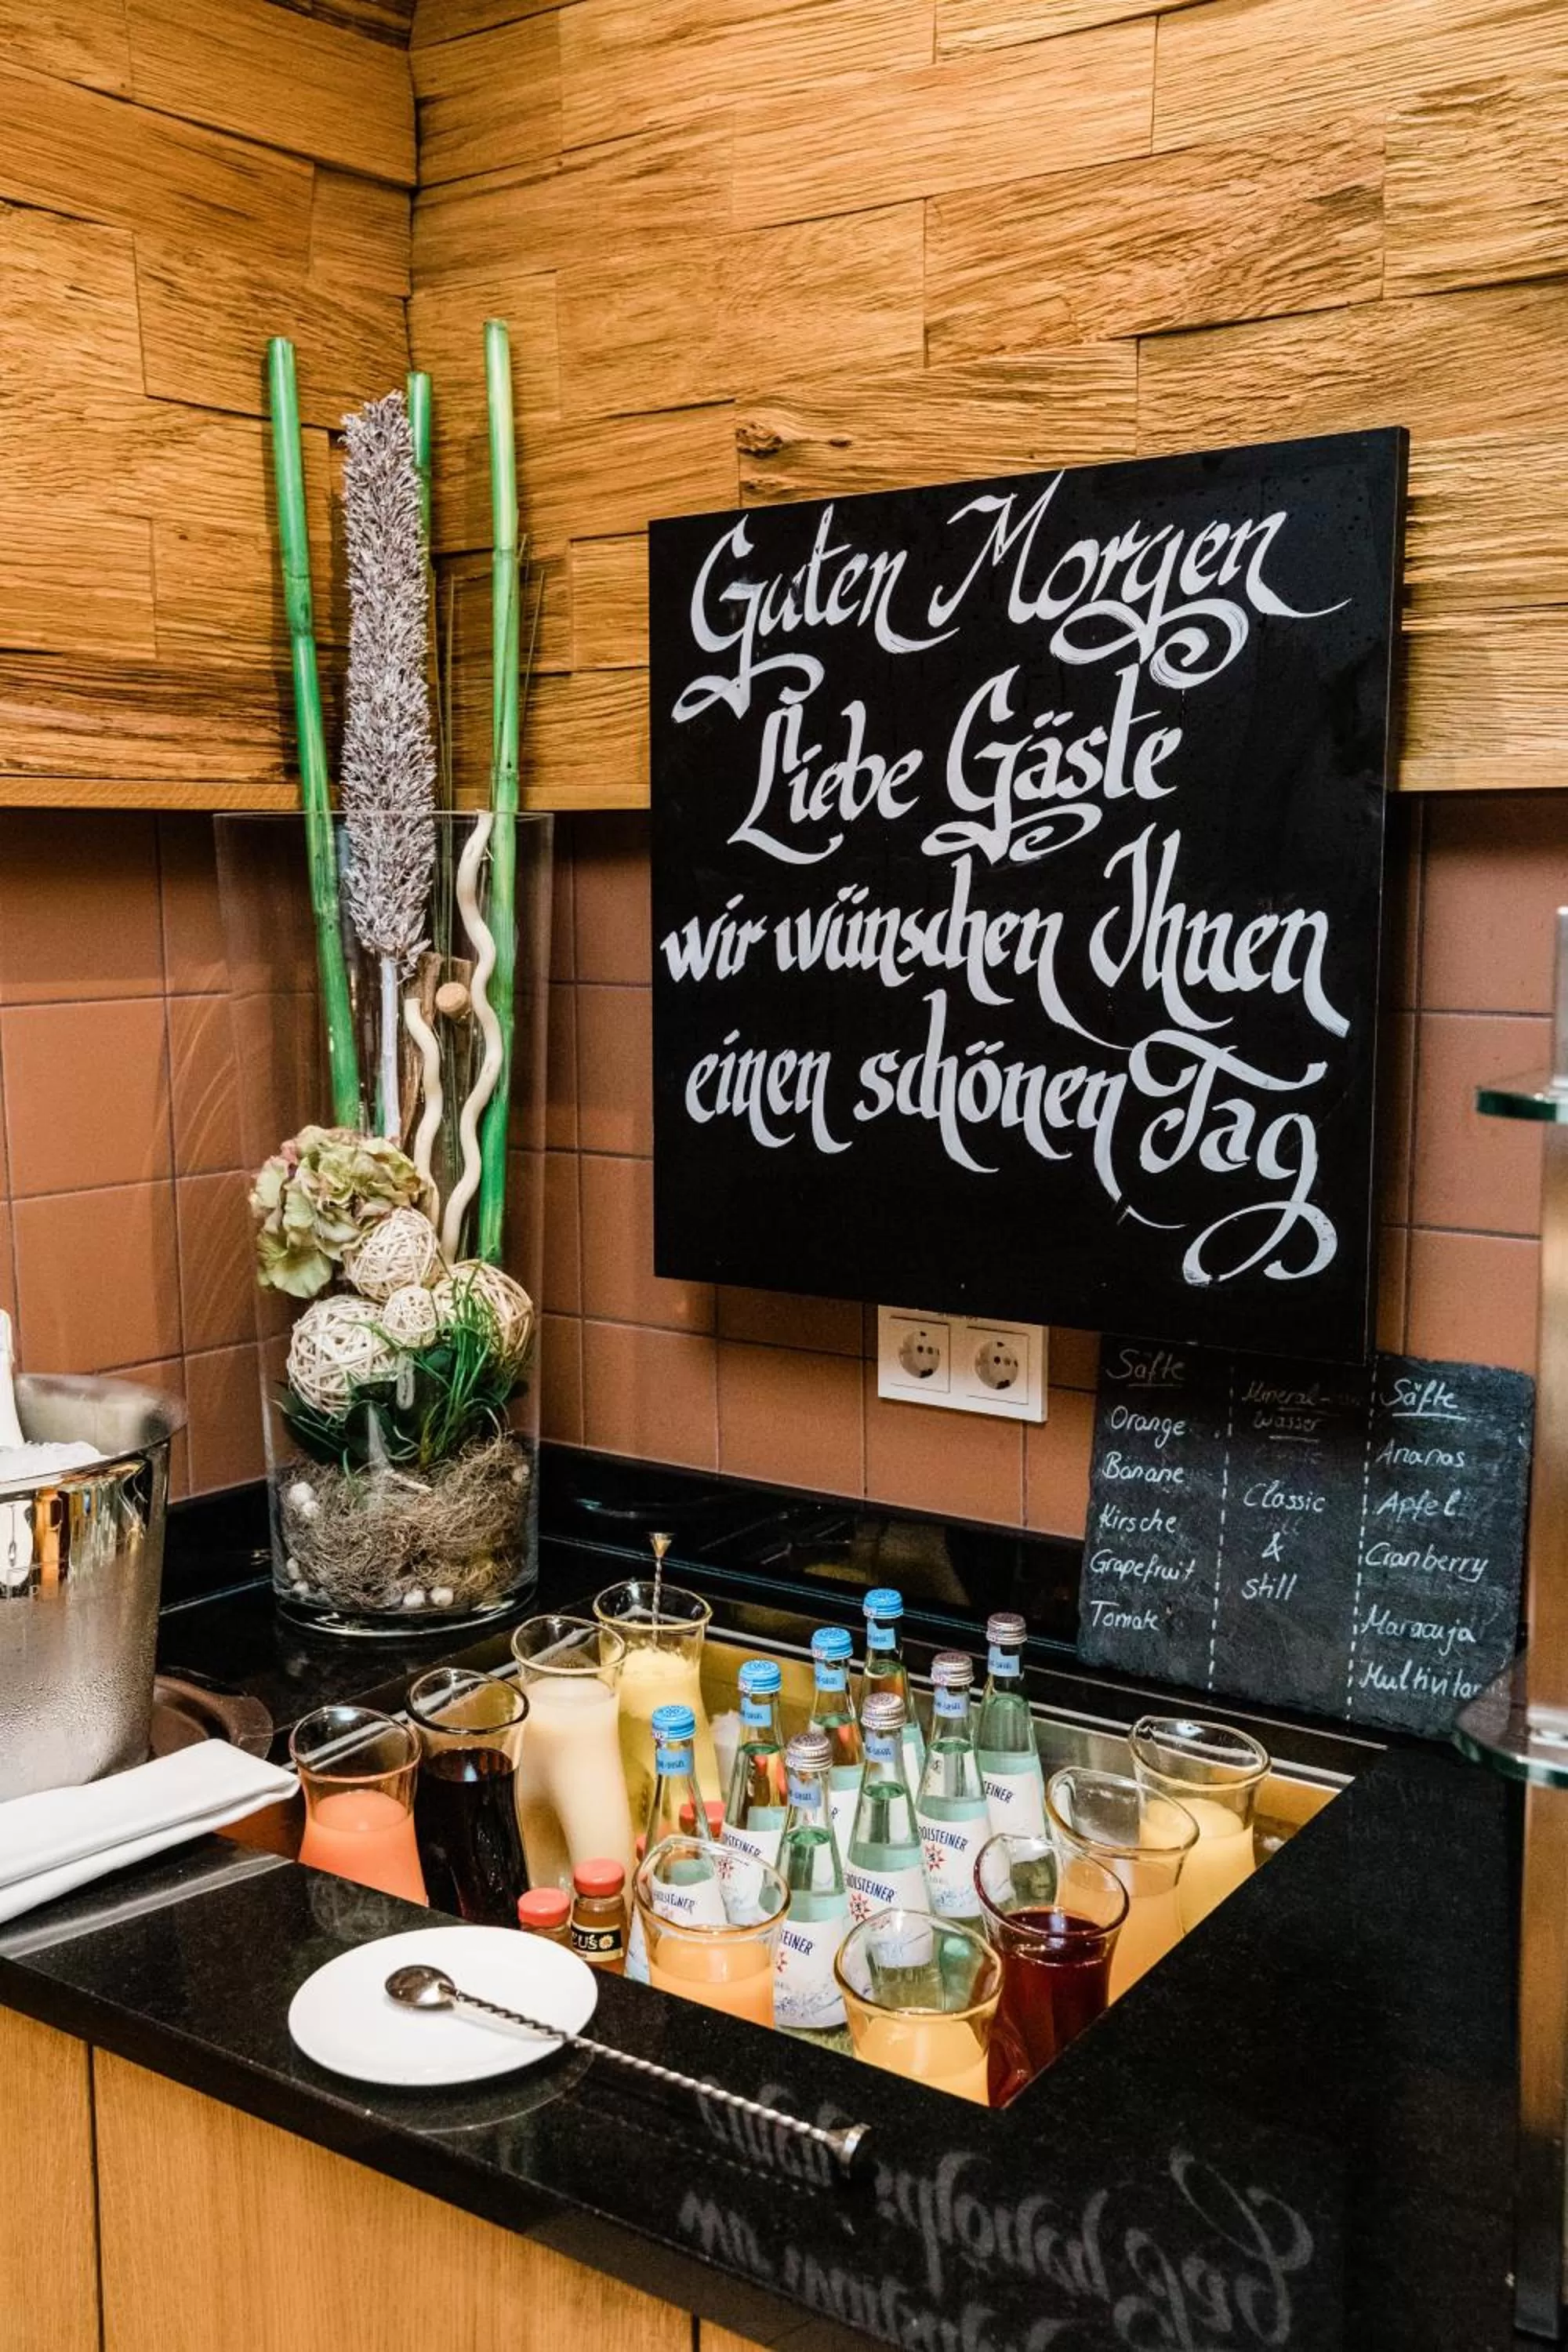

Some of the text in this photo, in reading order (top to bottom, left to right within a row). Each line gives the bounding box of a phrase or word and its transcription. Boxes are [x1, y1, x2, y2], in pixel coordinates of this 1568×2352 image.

[672, 470, 1351, 722] Guten Morgen
[727, 663, 1182, 864] Liebe Gäste
[660, 822, 1349, 1050] wir wünschen Ihnen
[686, 989, 1337, 1286] einen schönen Tag
[1380, 1379, 1459, 1414] Säfte
[1111, 1406, 1185, 1449] Orange
[1102, 1451, 1185, 1483] Banane
[1375, 1439, 1465, 1468] Ananas
[1243, 1479, 1327, 1512] Classic
[1376, 1489, 1462, 1523] Apfel
[1099, 1502, 1178, 1534] Kirsche
[1090, 1548, 1196, 1584] Grapefruit
[1365, 1542, 1488, 1582] Cranberry
[1091, 1600, 1161, 1632] Tomate
